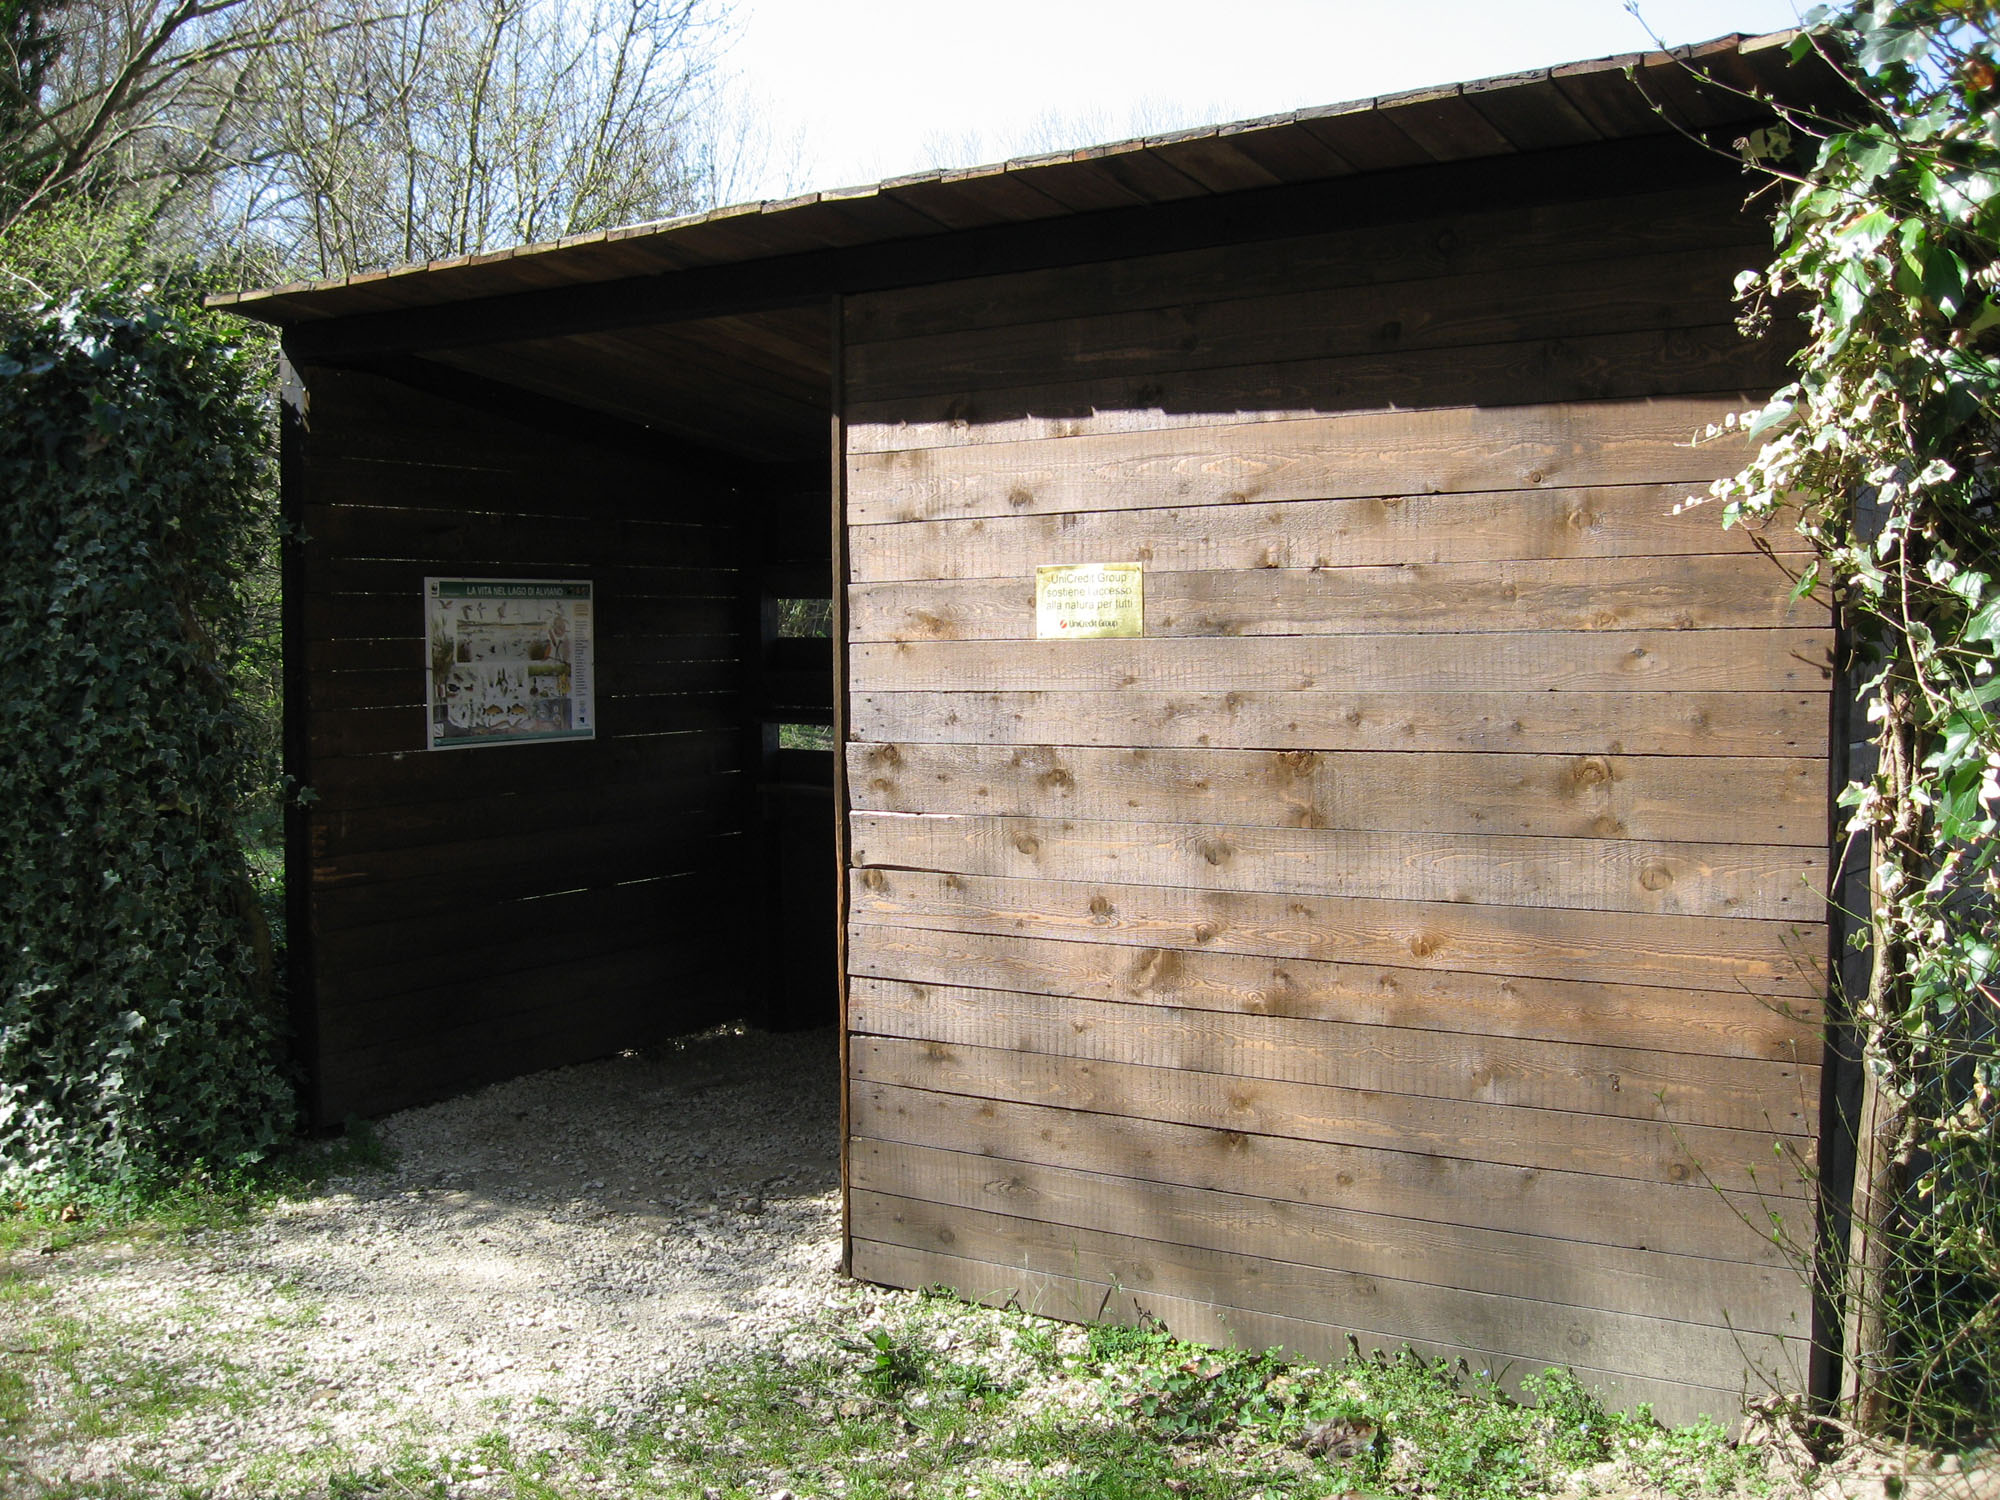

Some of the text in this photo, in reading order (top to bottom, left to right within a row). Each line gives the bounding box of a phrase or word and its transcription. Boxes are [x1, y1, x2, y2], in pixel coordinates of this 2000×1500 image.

[1051, 572, 1127, 584] UniCredit Group
[466, 585, 476, 595] LA
[477, 585, 492, 595] VITA
[493, 585, 506, 596] NEL
[507, 585, 526, 596] LAGO
[1047, 587, 1132, 598] sostiene laccesso
[1047, 599, 1133, 611] alla natura per tutti
